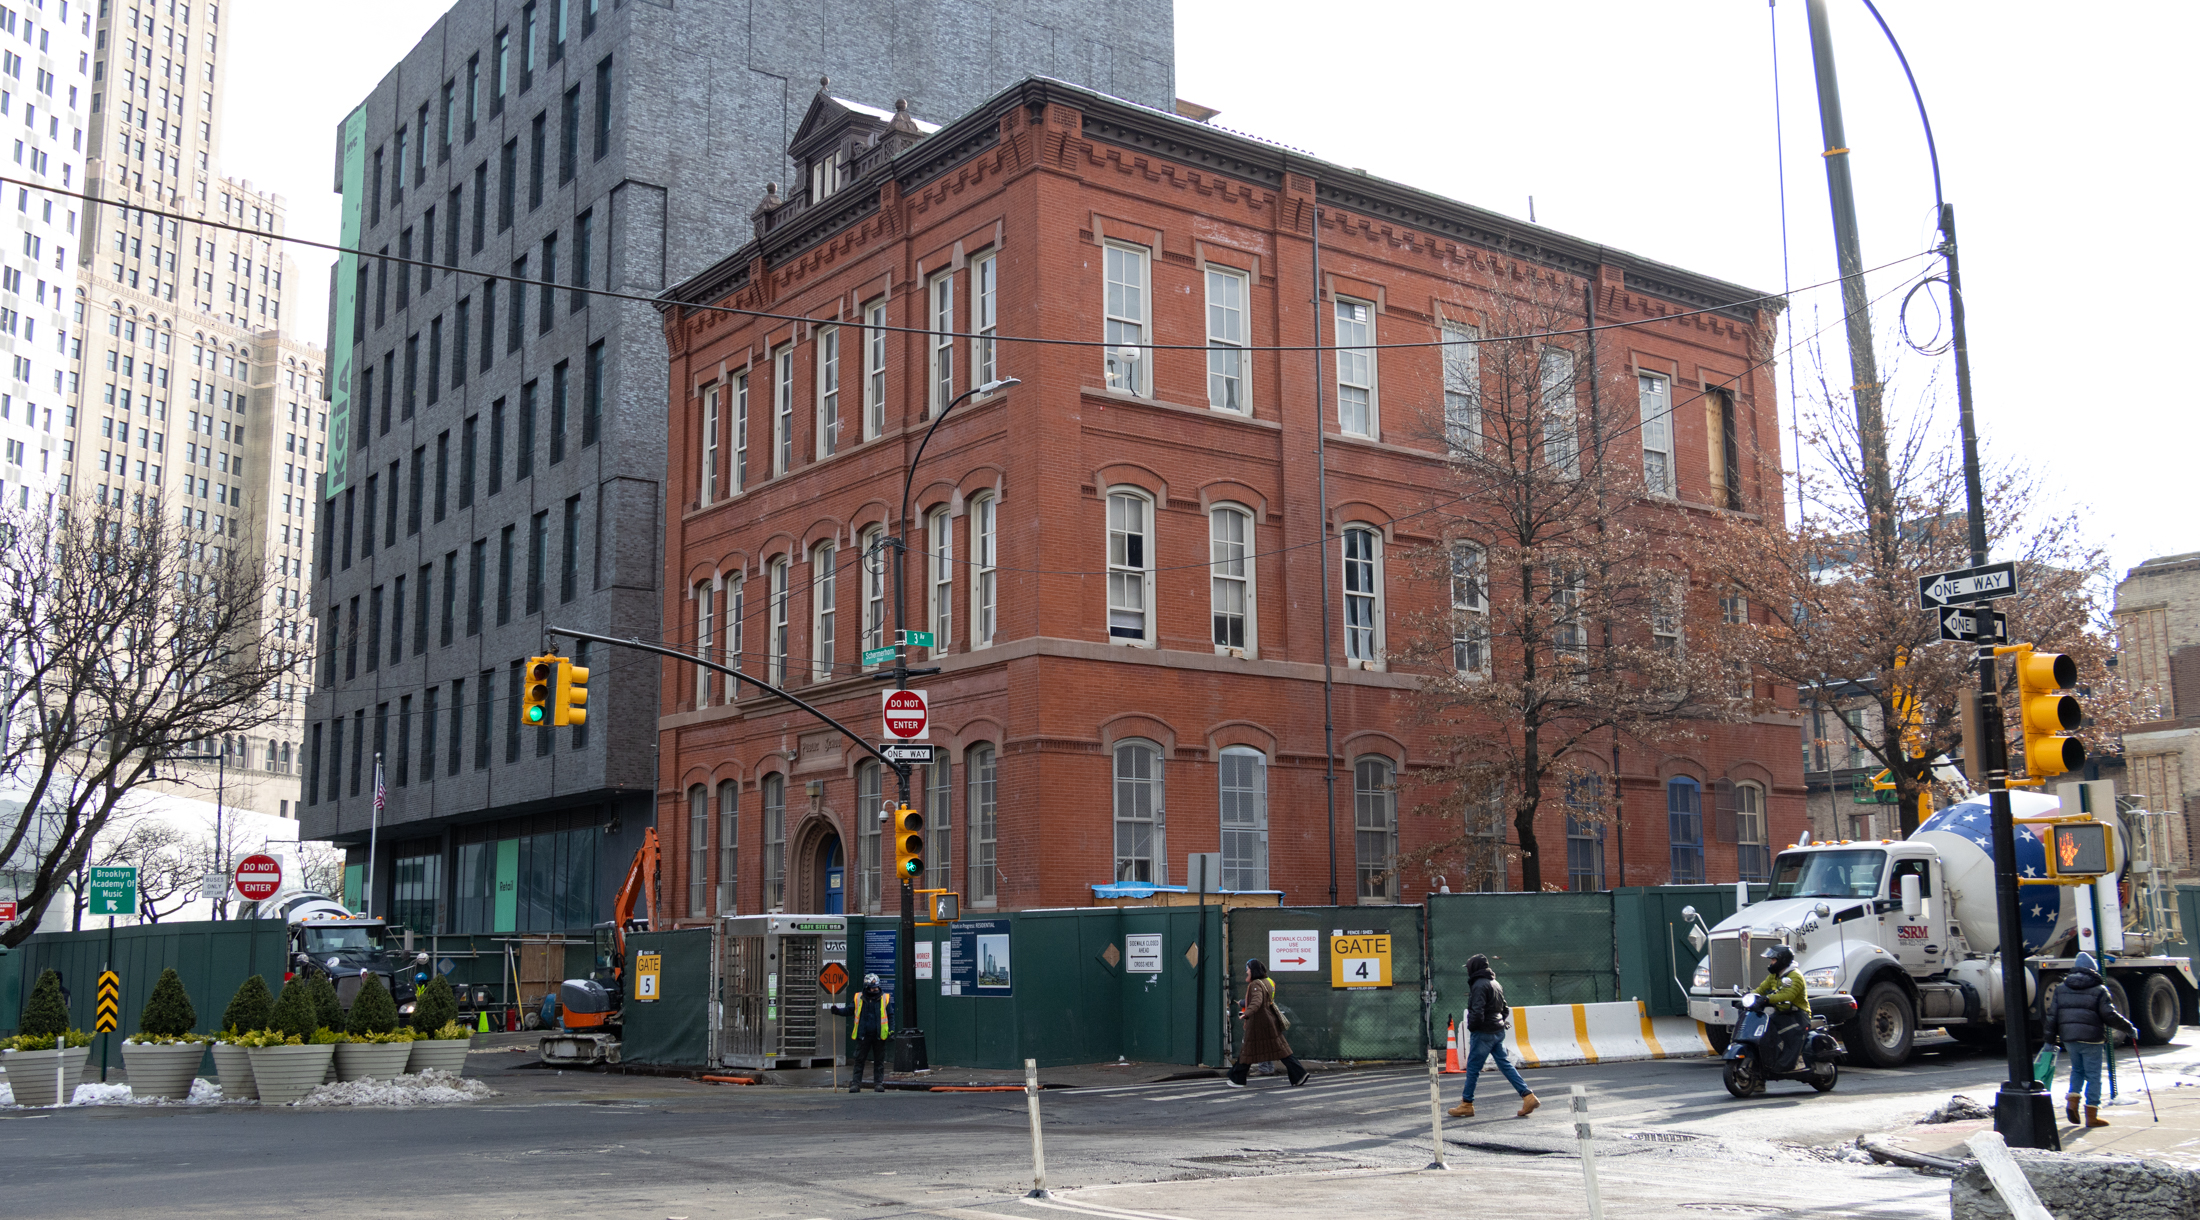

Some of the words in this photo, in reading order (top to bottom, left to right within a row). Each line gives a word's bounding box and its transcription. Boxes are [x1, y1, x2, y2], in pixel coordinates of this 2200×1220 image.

[1934, 581, 1961, 597] ONE
[1973, 574, 2002, 591] WAY
[1951, 617, 1971, 631] ONE
[913, 633, 918, 644] 3
[890, 699, 902, 708] DO
[904, 699, 919, 708] NOT
[893, 720, 919, 729] ENTER
[887, 750, 903, 758] ONE
[910, 750, 926, 758] WAY
[243, 863, 256, 871] DO
[258, 863, 274, 871] NOT
[96, 869, 131, 879] Brooklyn
[91, 880, 124, 889] Academy
[244, 883, 272, 892] ENTER
[499, 880, 514, 891] Retail
[102, 890, 123, 898] Music
[1902, 925, 1929, 939] SRM
[825, 941, 846, 951] UAG
[1334, 938, 1387, 954] GATE
[637, 957, 659, 972] GATE
[1355, 961, 1369, 979] 4
[823, 973, 845, 985] SLOW
[644, 977, 651, 993] 5
